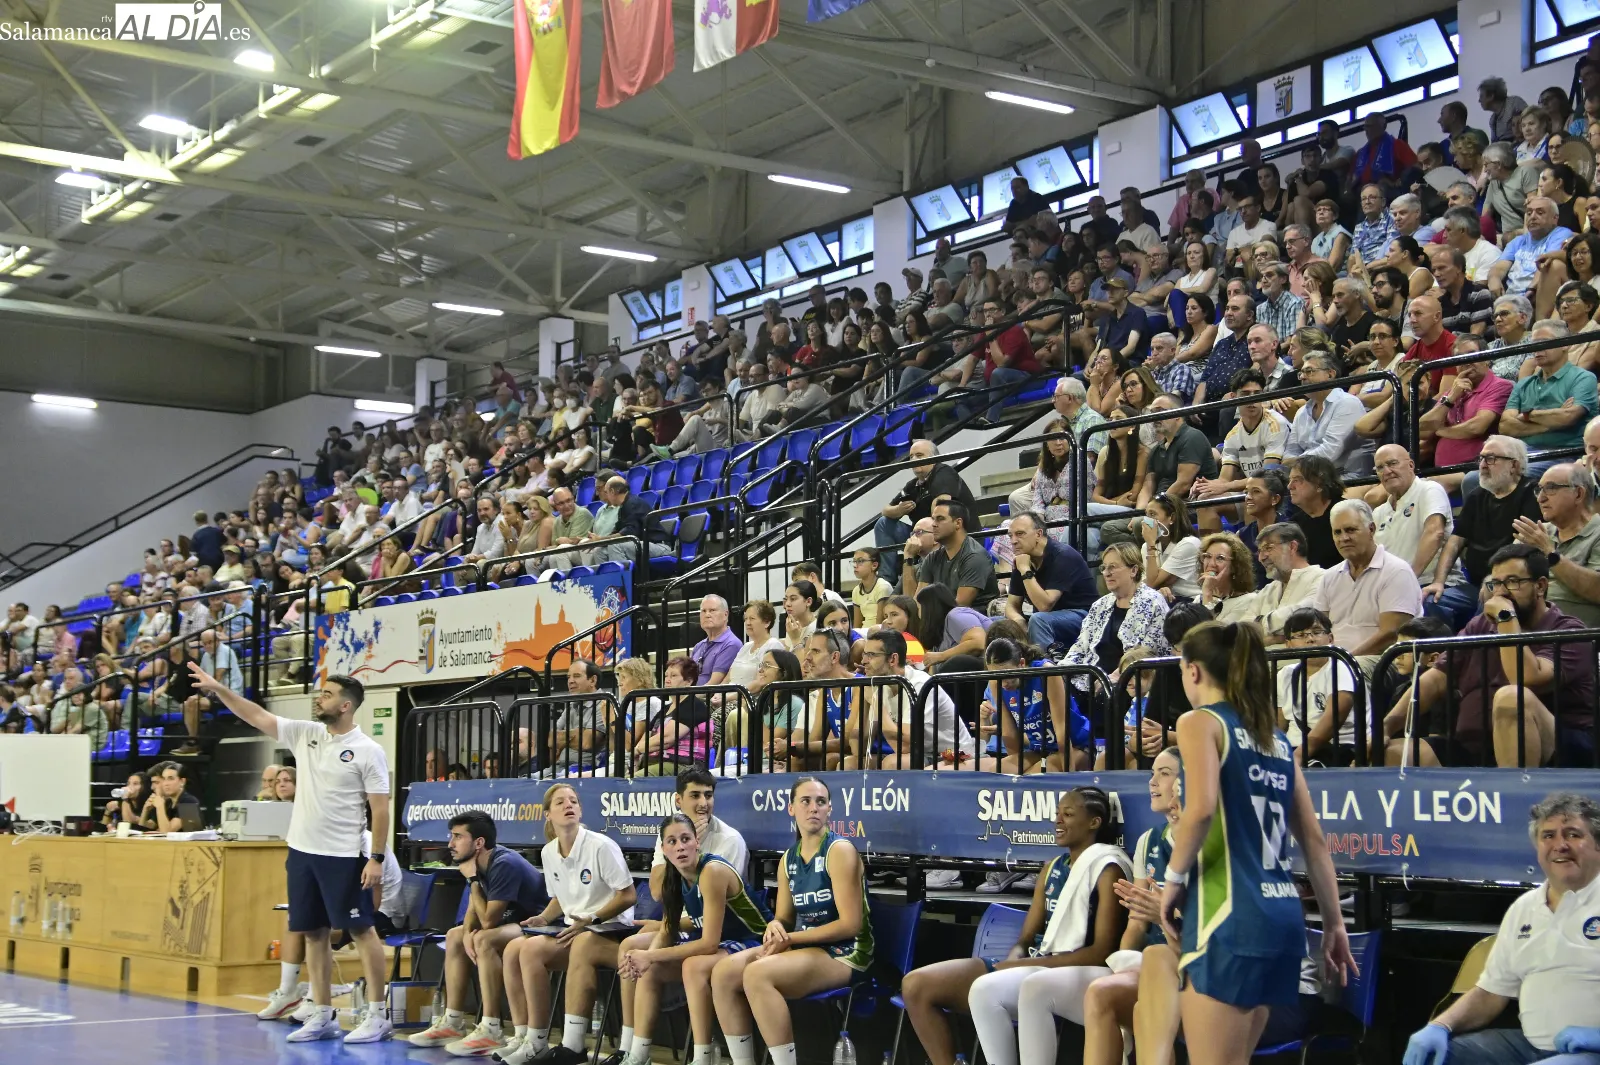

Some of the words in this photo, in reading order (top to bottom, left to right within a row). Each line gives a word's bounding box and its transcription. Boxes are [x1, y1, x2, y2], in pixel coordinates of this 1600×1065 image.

[439, 625, 492, 649] Ayuntamiento
[439, 651, 448, 668] de
[450, 649, 492, 667] Salamanca
[601, 792, 684, 817] SALAMANC
[842, 788, 854, 816] Y
[861, 779, 909, 811] LEÓN
[977, 789, 1125, 824] SALAMA
[1378, 790, 1400, 828] Y
[1413, 779, 1502, 824] LEÓN
[622, 823, 649, 834] Patrimonio
[649, 823, 656, 834] de
[1012, 830, 1055, 843] Patrimonio
